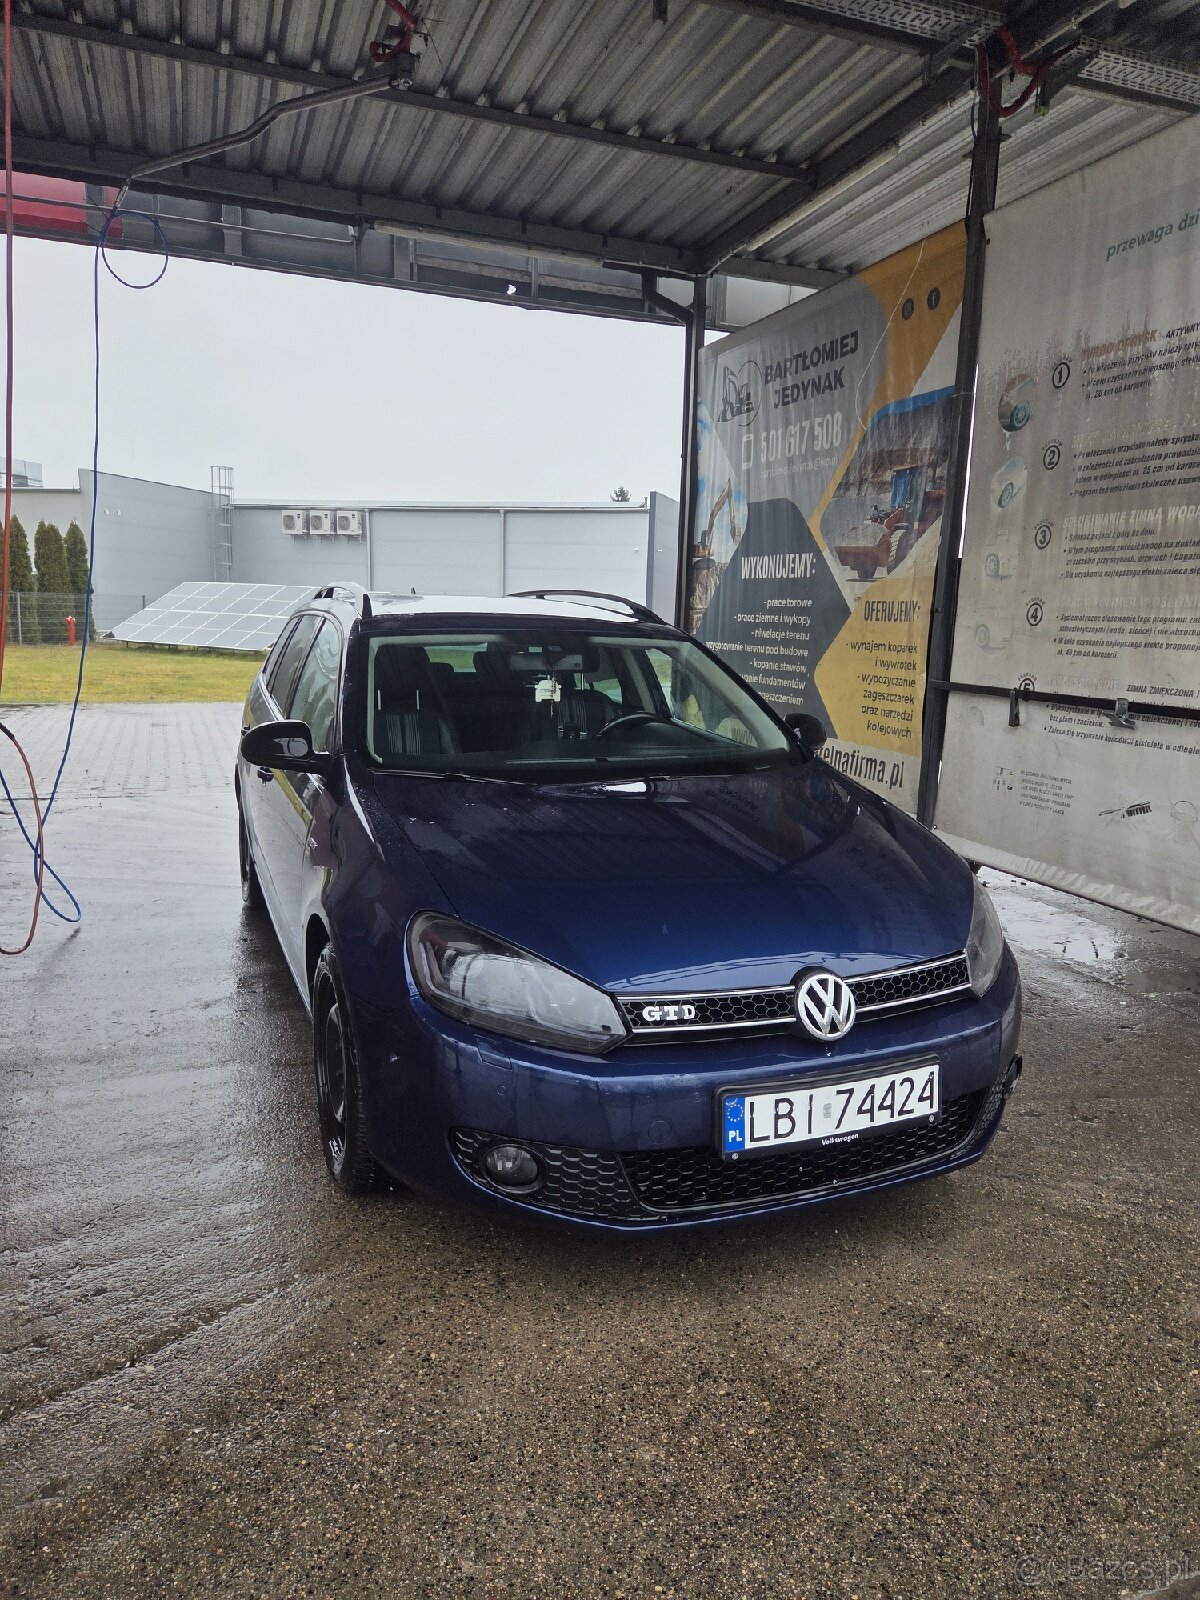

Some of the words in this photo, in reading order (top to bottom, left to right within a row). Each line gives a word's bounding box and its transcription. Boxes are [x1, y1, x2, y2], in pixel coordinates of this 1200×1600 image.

[1106, 224, 1173, 262] przewaga
[765, 330, 858, 385] BARTŁOMIEJ
[773, 366, 845, 409] JEDYNAK
[761, 427, 782, 464] 501
[786, 419, 810, 457] 617
[814, 411, 843, 451] 508
[741, 553, 816, 579] WYKONUJEMY:
[766, 599, 786, 610] prace
[786, 598, 813, 608] torowe
[864, 600, 921, 623] OFERUJEMY:
[737, 613, 755, 624] prace
[755, 613, 779, 623] ziemne
[784, 613, 811, 627] wykopy
[754, 628, 785, 642] niwelacje
[786, 630, 810, 641] terenu
[765, 645, 779, 656] pod
[850, 640, 887, 652] wynajem
[888, 640, 918, 654] koparek
[753, 658, 779, 671] kopanie
[879, 658, 917, 672] wywrotek
[758, 673, 806, 690] fundamentów
[863, 689, 915, 706] zagęszczarek
[861, 705, 879, 717] oraz
[880, 708, 914, 723] narzędzi
[866, 720, 912, 739] kolejowych
[642, 1004, 695, 1022] GTD
[749, 1094, 814, 1144] LBI
[834, 1071, 934, 1130] 74424
[728, 1130, 742, 1143] PL
